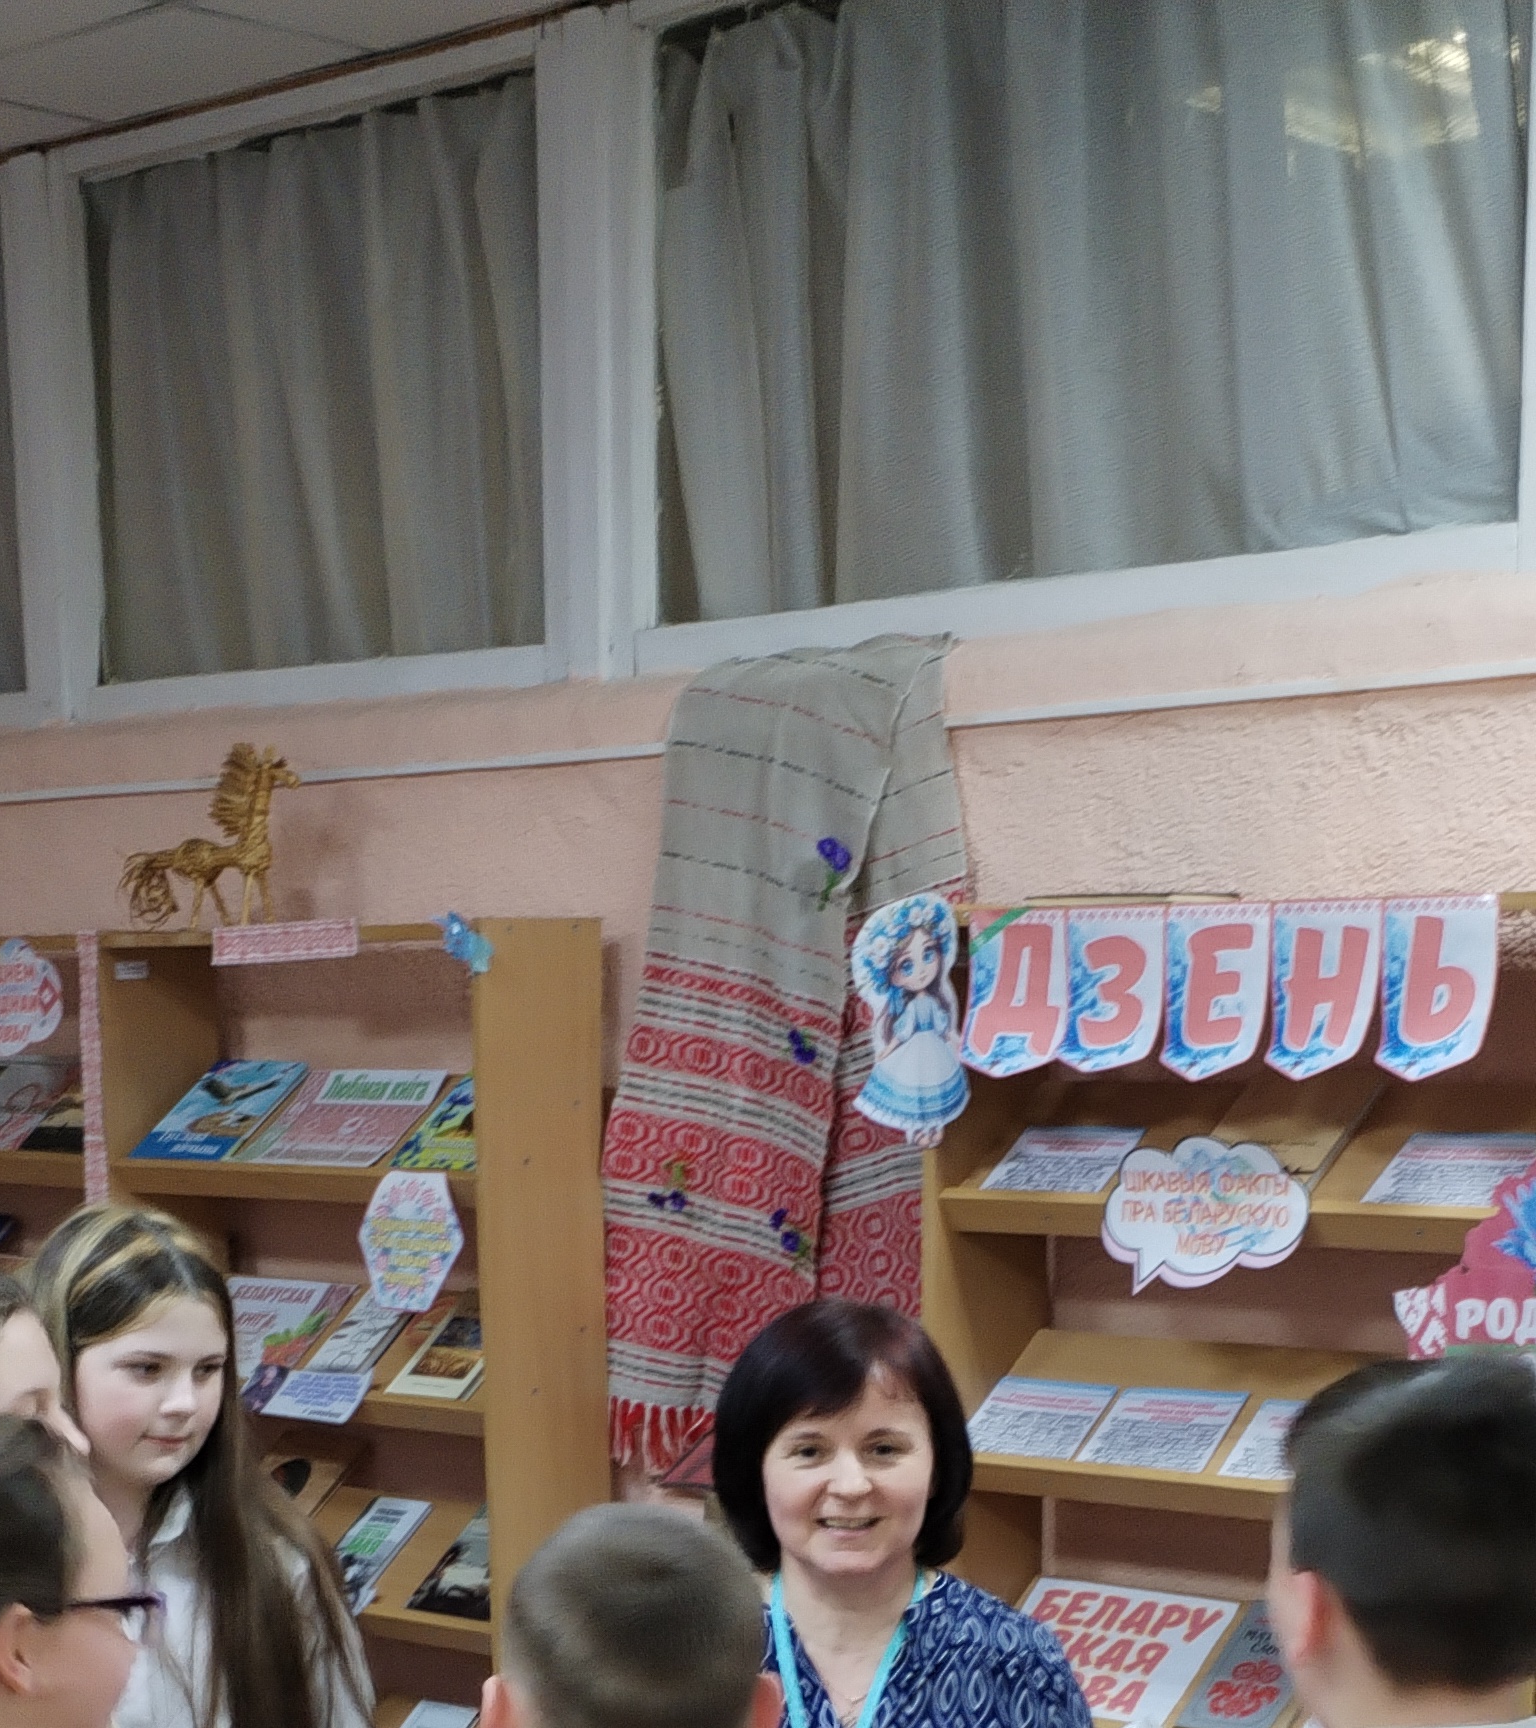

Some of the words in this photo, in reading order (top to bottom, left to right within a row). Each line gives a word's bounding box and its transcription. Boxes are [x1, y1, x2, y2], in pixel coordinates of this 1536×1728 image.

[967, 916, 1476, 1056] ДЗЕНЬ
[1219, 1171, 1291, 1195] ФАКТЫ
[1121, 1200, 1156, 1222] ПРА
[1163, 1201, 1290, 1227] БЕЛАРУСКУЮ
[1175, 1233, 1228, 1255] МОВУ
[1031, 1589, 1224, 1643] БЕЛАРУ
[1074, 1671, 1149, 1716] ВА
